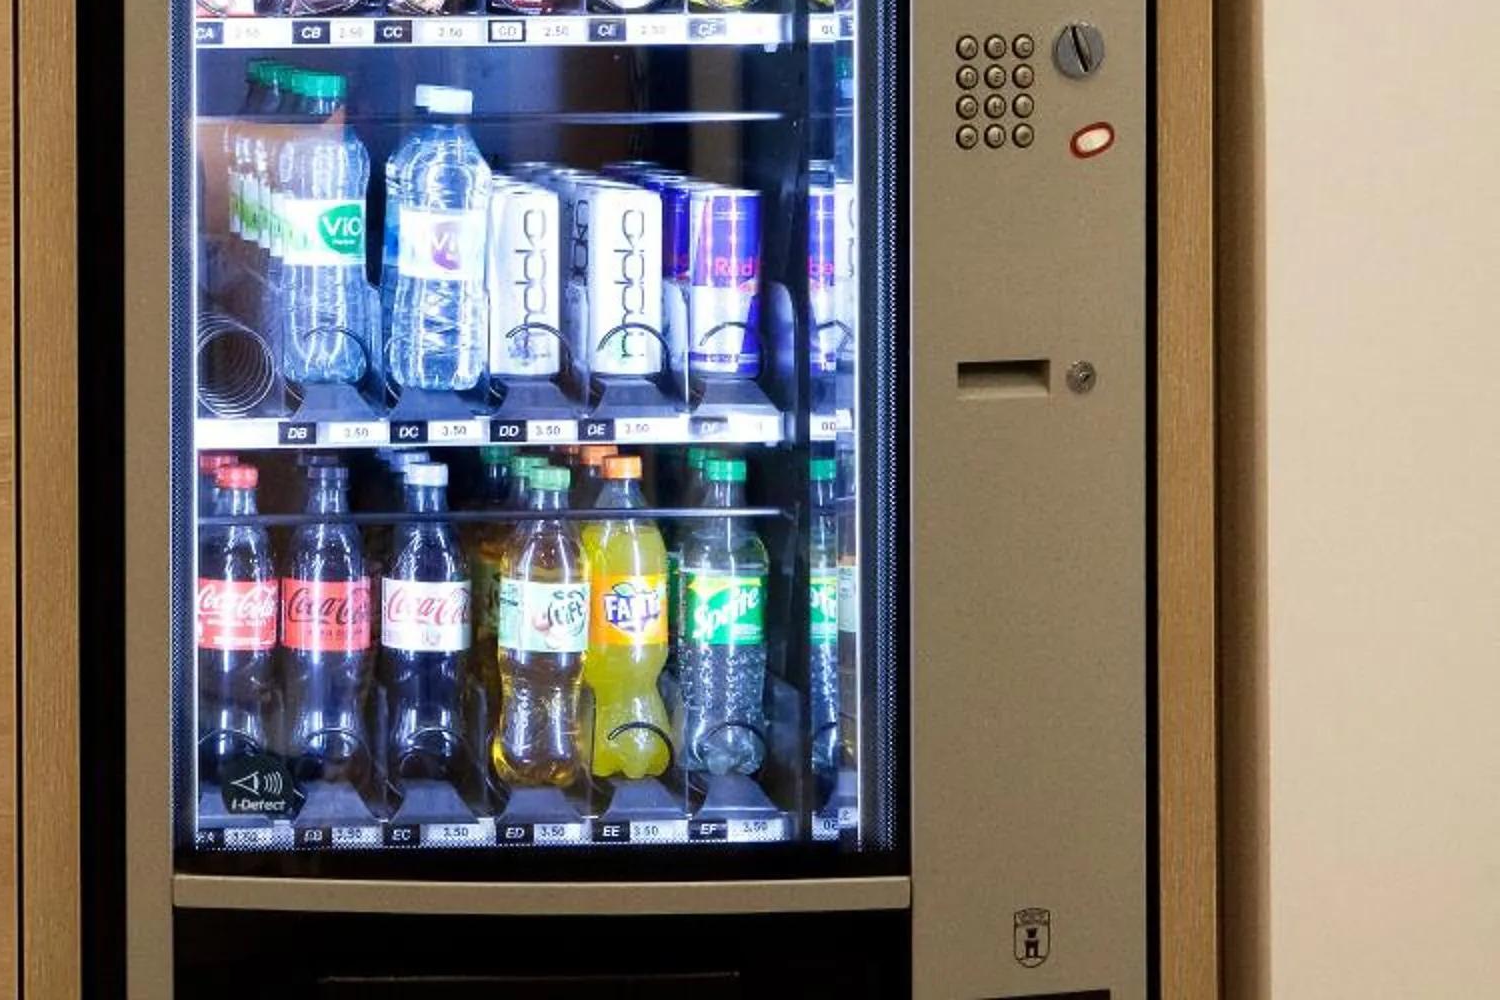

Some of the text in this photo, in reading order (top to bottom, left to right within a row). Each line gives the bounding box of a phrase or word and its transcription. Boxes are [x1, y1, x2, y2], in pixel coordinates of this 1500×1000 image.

[302, 27, 321, 39] CB
[383, 26, 403, 38] CC
[287, 427, 307, 439] DB
[399, 425, 467, 439] DC 3.50
[587, 423, 606, 436] DE
[692, 587, 759, 640] Sprite
[392, 828, 411, 841] EC
[505, 825, 565, 839] ED 3.50
[602, 825, 620, 837] EE
[699, 823, 717, 836] EF
